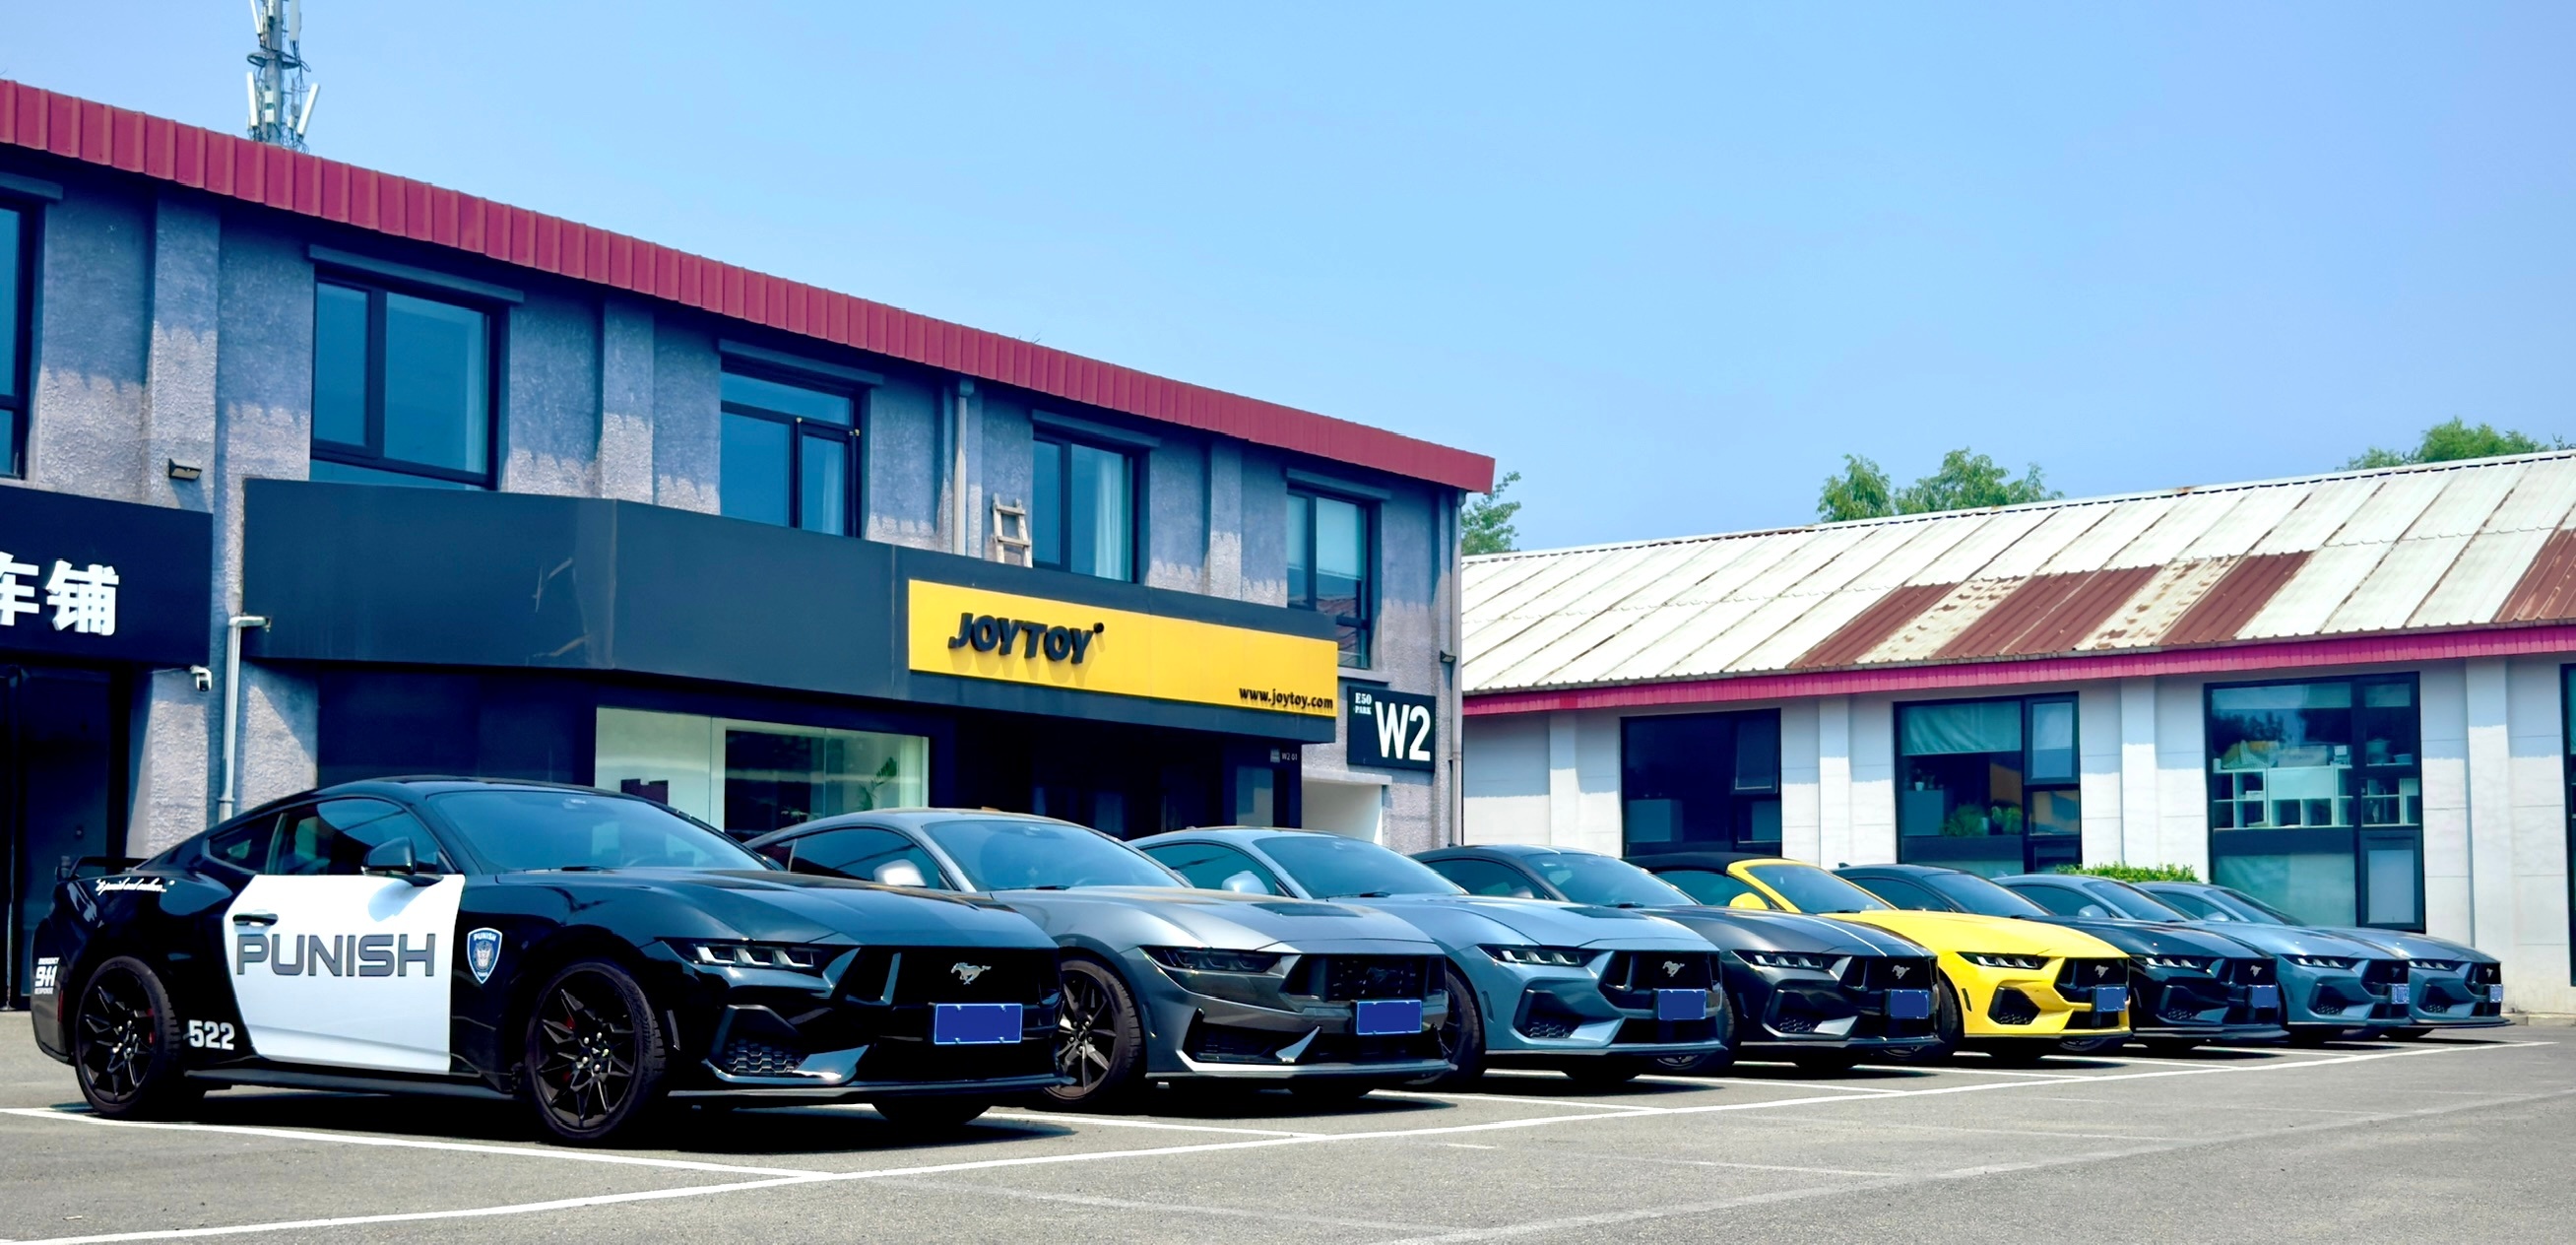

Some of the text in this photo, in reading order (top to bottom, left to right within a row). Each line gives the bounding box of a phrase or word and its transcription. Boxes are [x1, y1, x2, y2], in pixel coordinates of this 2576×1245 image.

[947, 612, 1095, 665] JOYTOY
[1238, 688, 1334, 709] www.joytoy.com
[1354, 705, 1373, 715] PARK
[1355, 692, 1373, 705] E50
[1375, 700, 1432, 762] W2
[236, 933, 436, 977] PUNISH
[188, 1019, 235, 1051] 522
